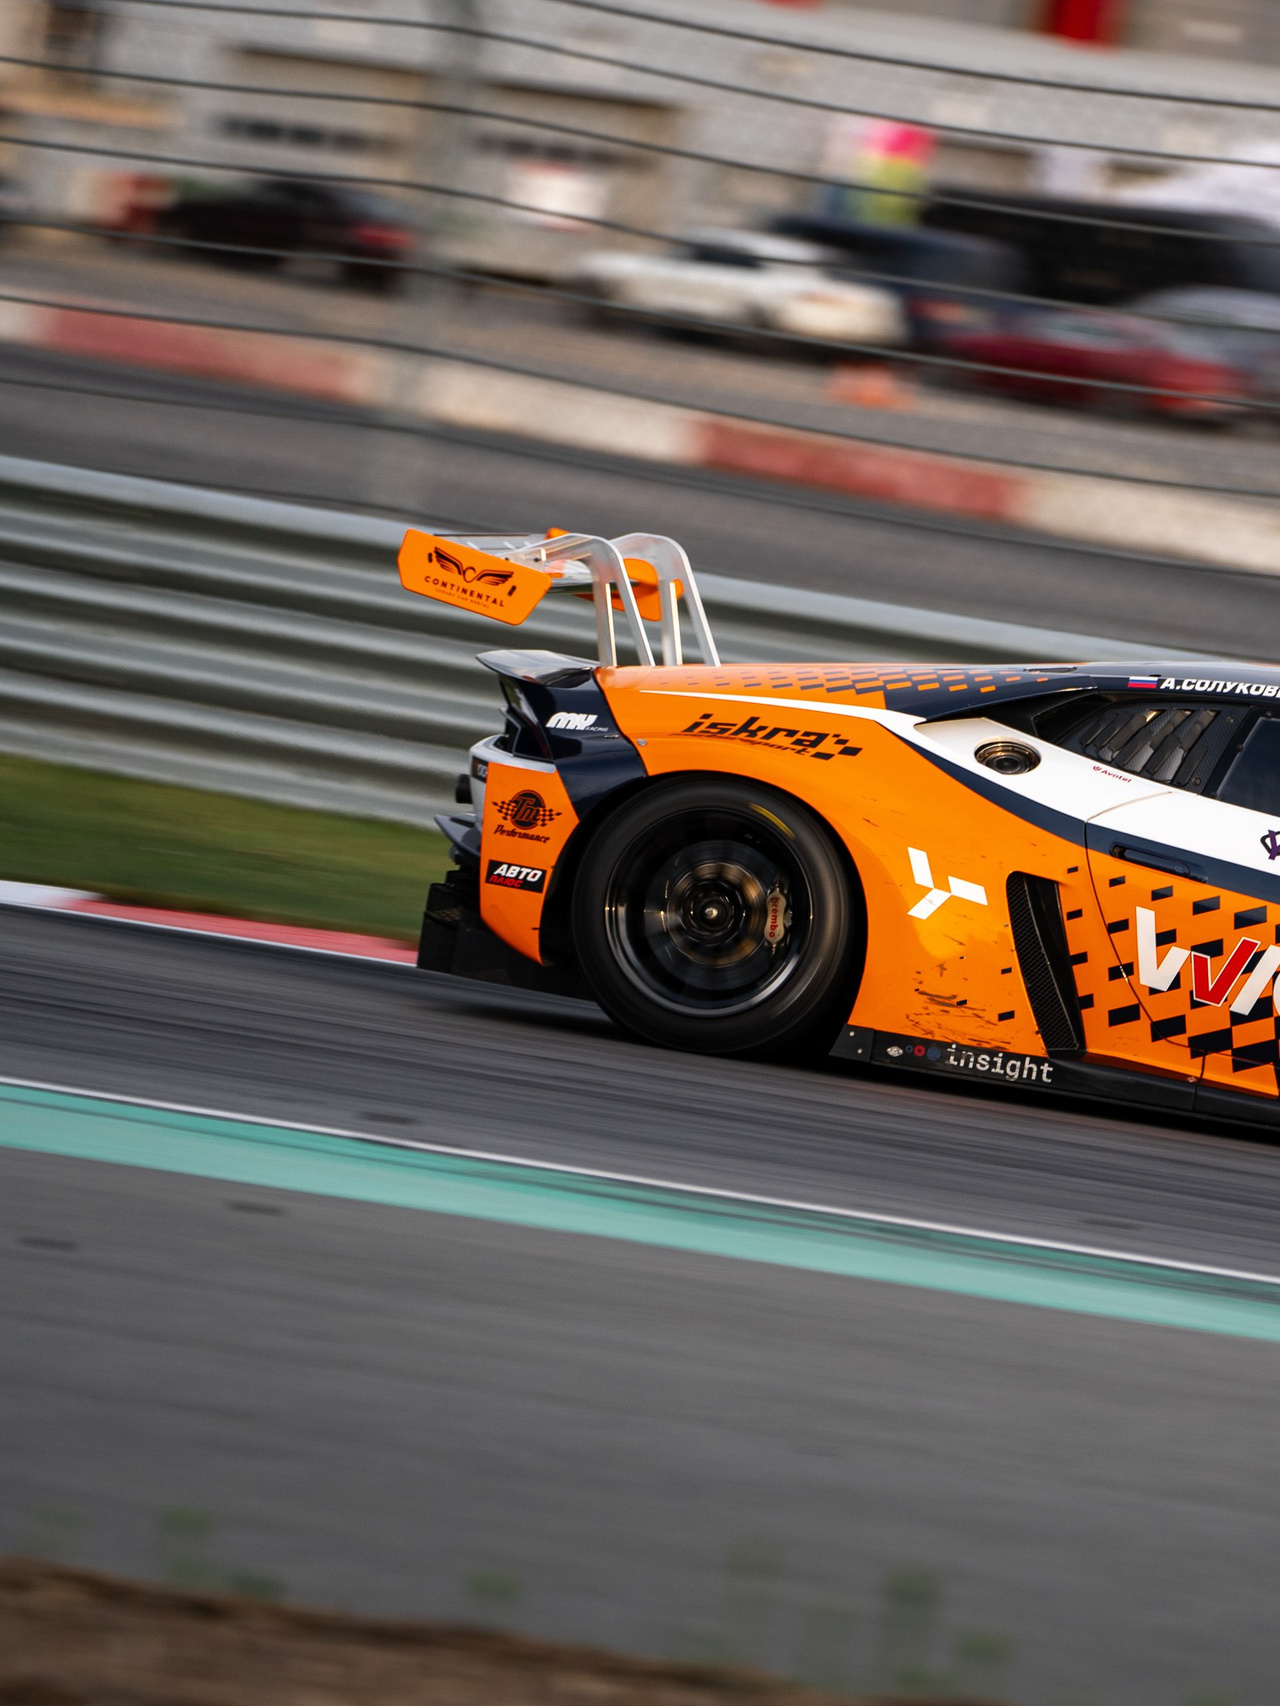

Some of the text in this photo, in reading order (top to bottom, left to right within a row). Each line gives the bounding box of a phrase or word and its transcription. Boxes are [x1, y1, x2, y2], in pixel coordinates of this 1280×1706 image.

[424, 575, 504, 607] CONTINENTAL
[545, 711, 598, 731] MY
[681, 713, 830, 748] iskra
[493, 824, 550, 844] Performance
[488, 875, 523, 888] ПЛЮС
[493, 864, 542, 882] АВТО
[945, 1043, 1054, 1083] insight
